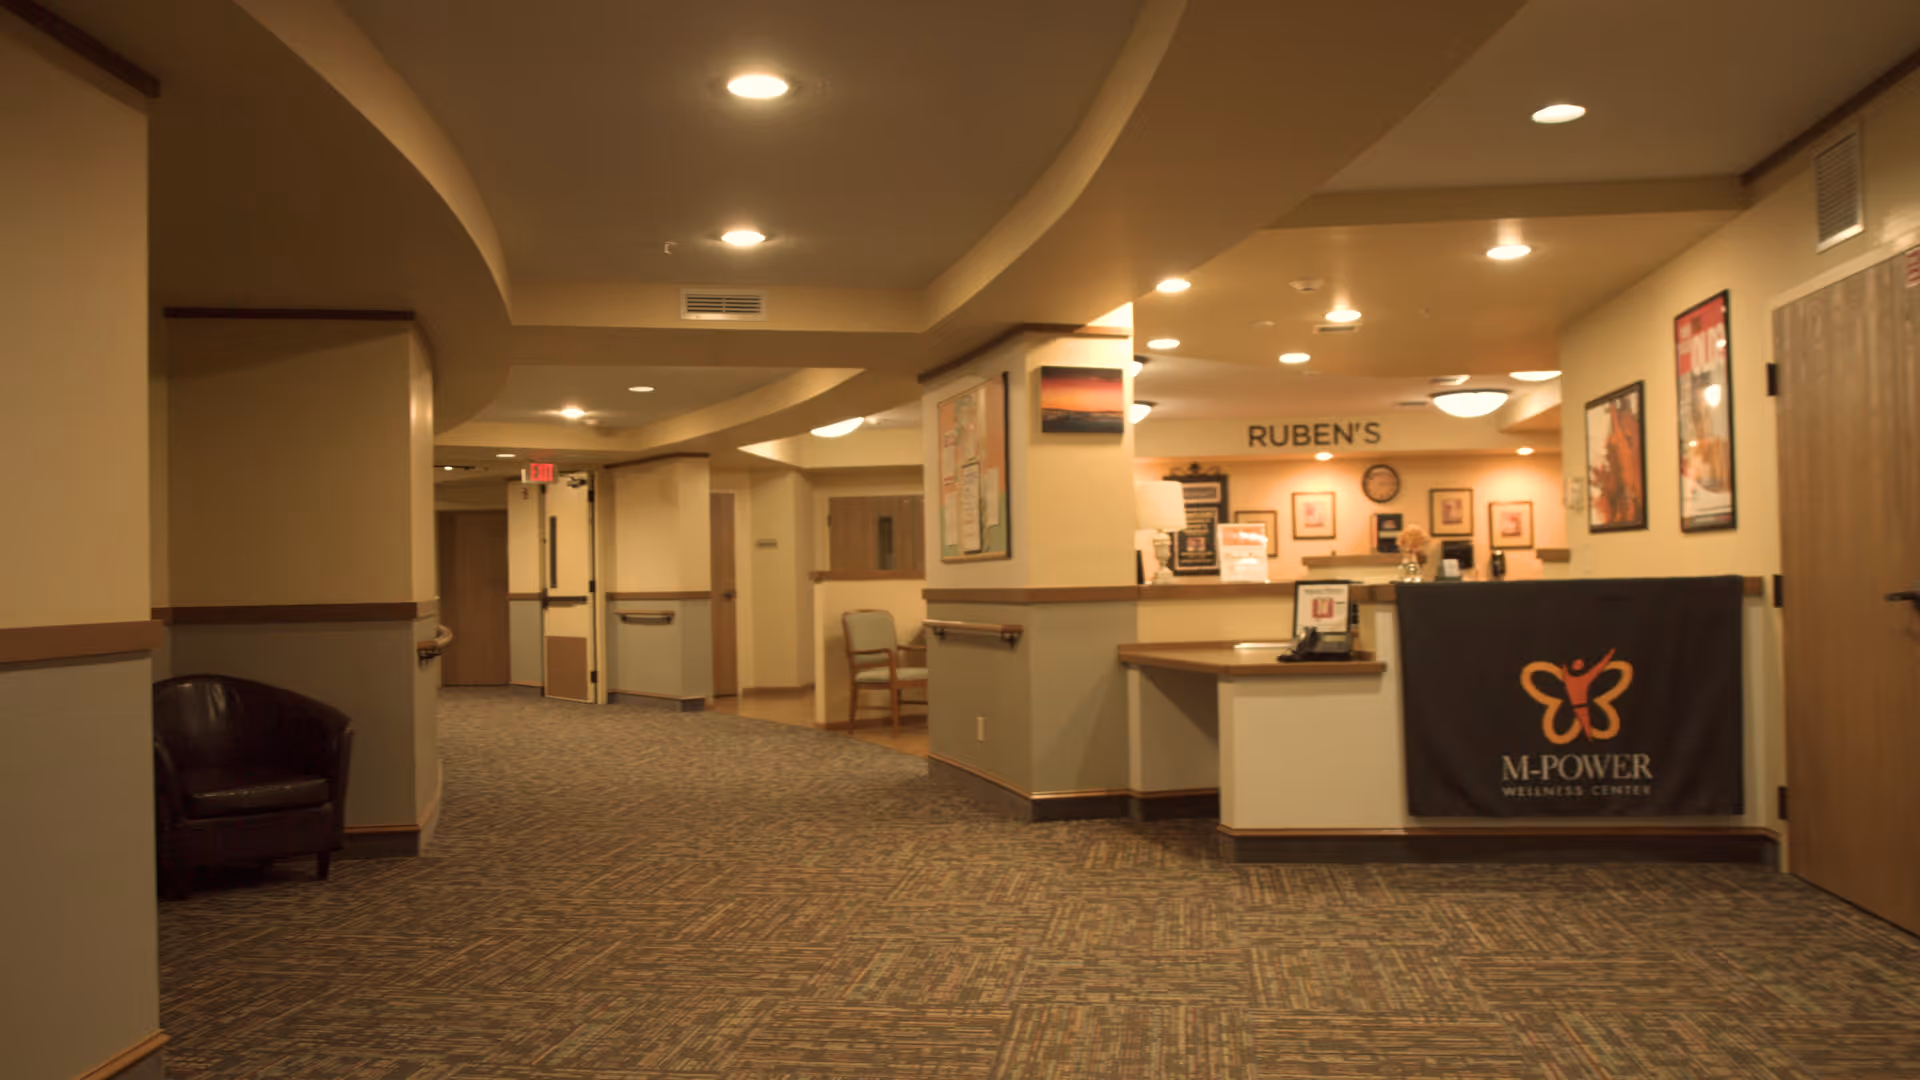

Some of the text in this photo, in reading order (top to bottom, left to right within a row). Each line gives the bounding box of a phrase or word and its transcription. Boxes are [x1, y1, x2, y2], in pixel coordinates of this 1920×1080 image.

[1249, 422, 1381, 447] RUBEN'S
[530, 463, 554, 482] EXIT
[1502, 753, 1653, 781] M-POWER
[1502, 785, 1652, 797] WELLNESS CENTER
